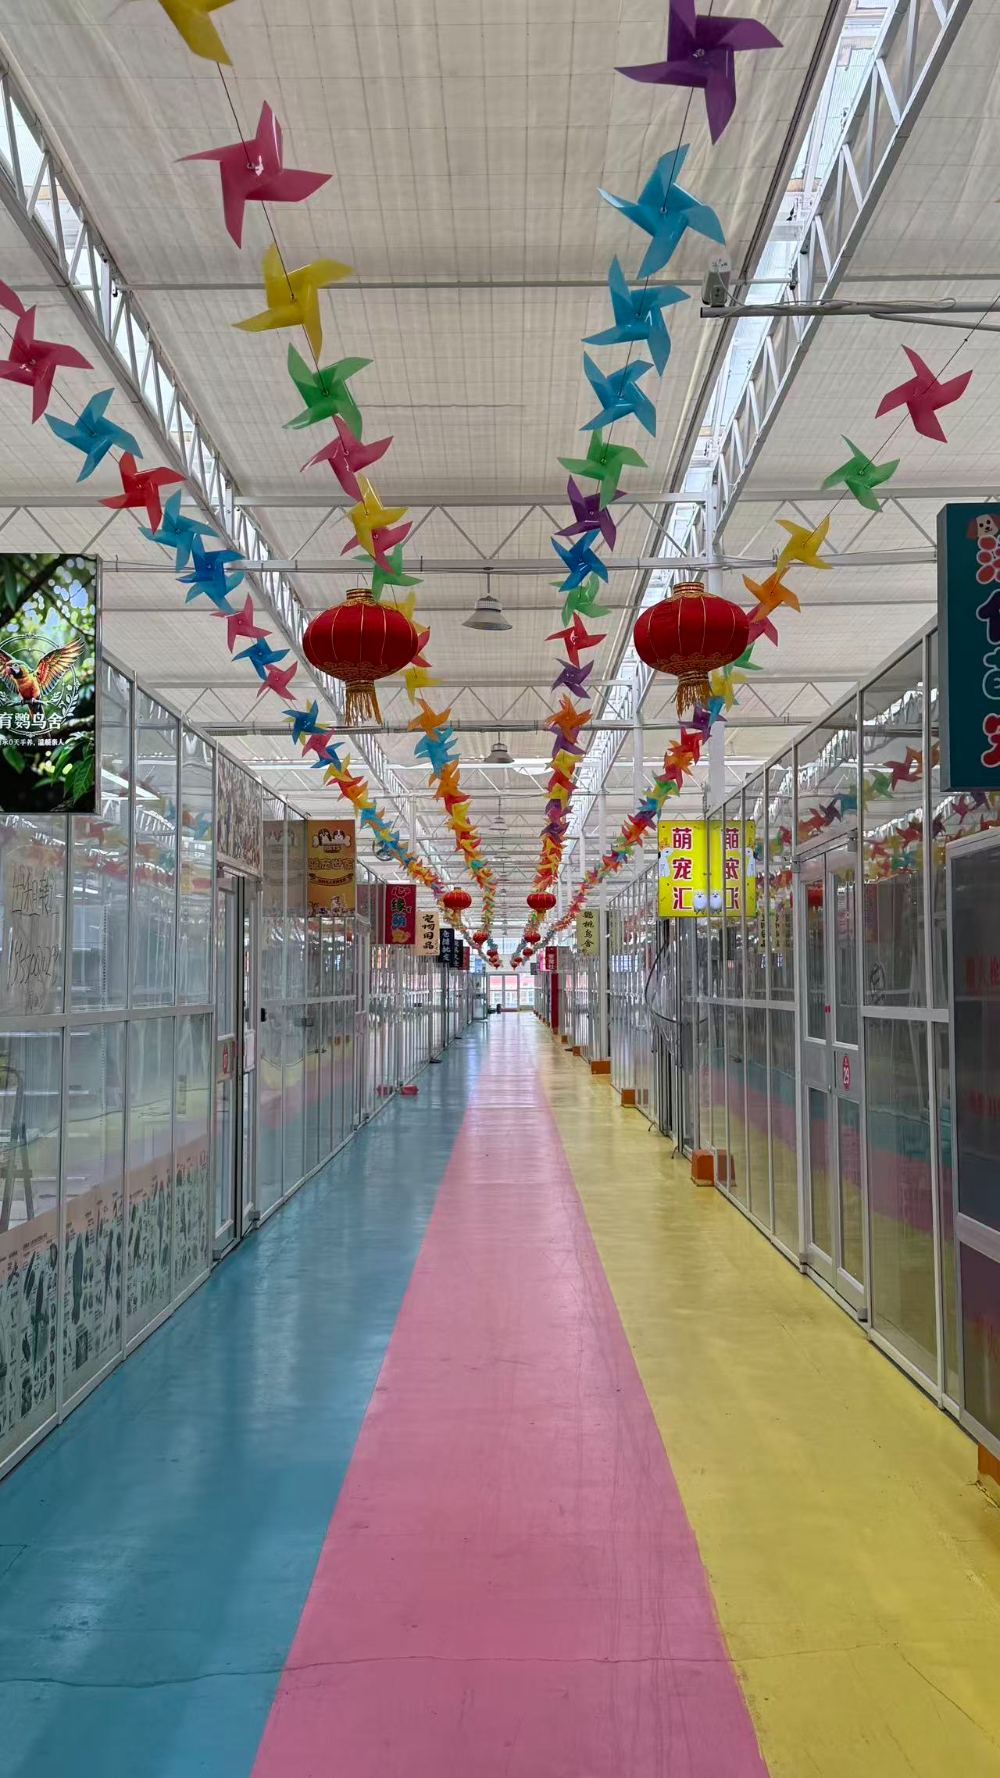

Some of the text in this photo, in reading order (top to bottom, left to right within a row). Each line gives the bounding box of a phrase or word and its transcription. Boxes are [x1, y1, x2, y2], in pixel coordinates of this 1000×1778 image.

[672, 828, 692, 910] 萌宠汇
[421, 914, 435, 950] 宠物用品
